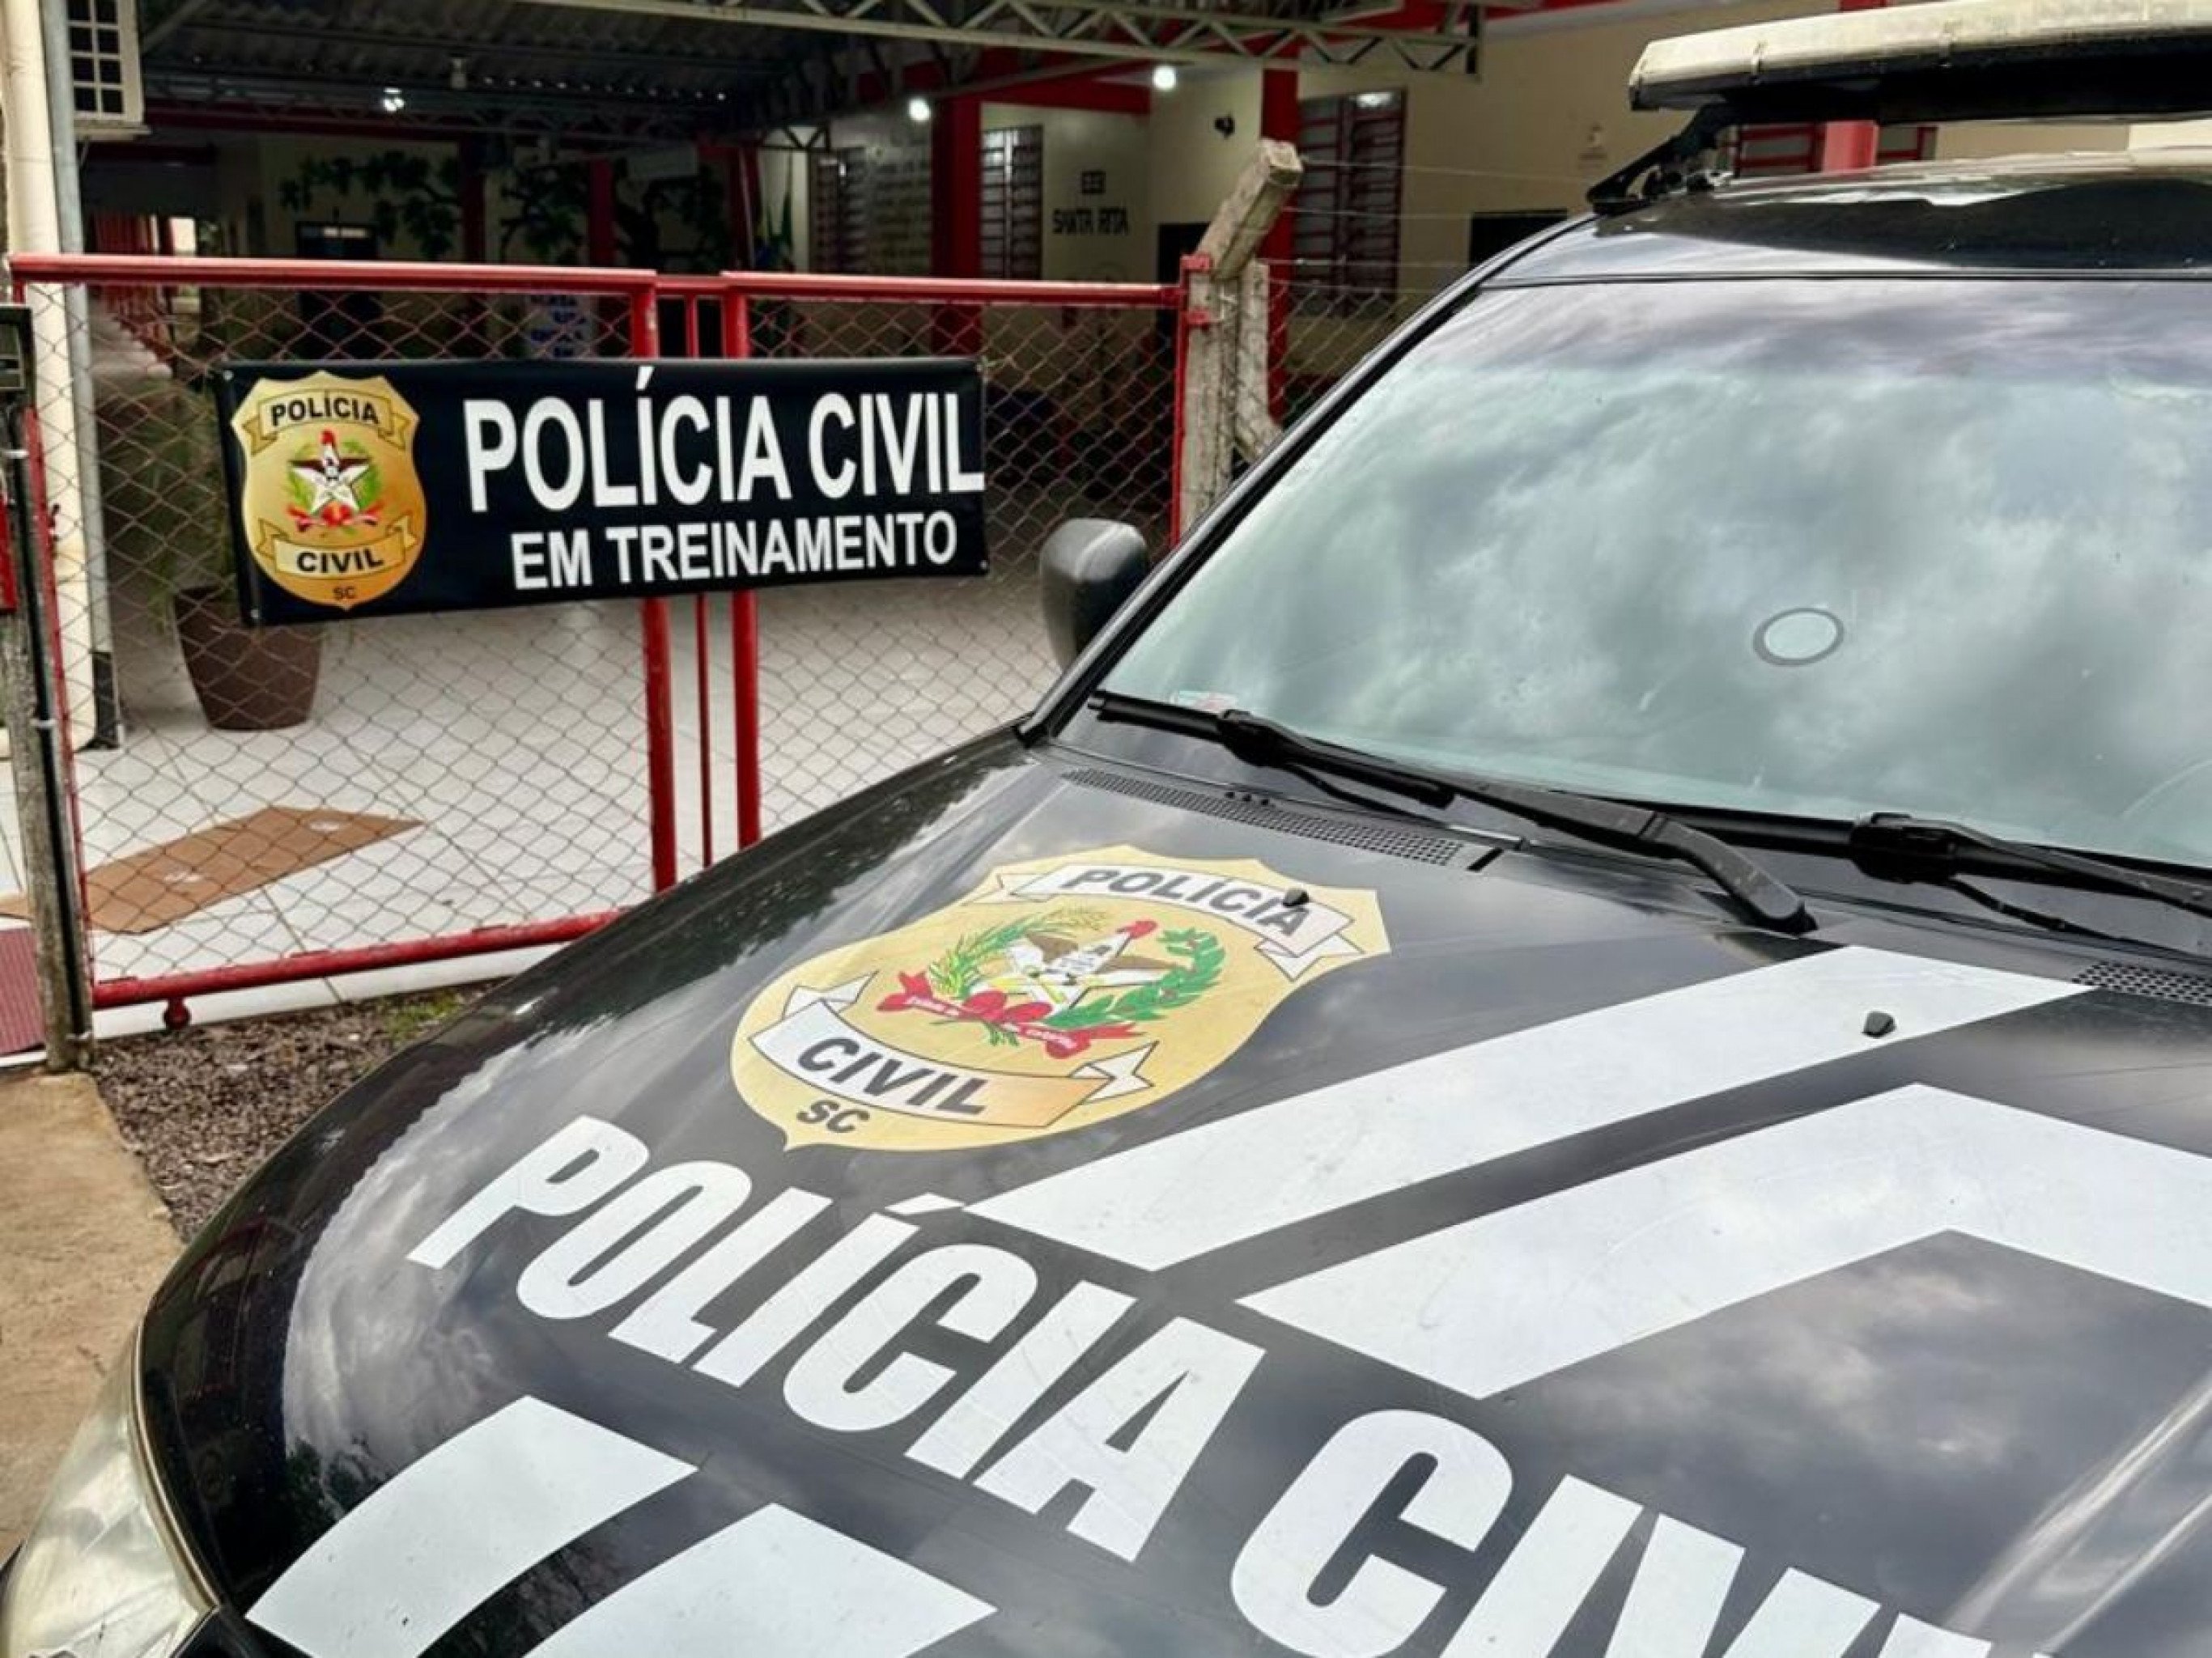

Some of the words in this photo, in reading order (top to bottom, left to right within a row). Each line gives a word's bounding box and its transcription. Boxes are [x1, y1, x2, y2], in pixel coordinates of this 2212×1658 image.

[271, 392, 380, 426] POLÍCIA
[464, 366, 792, 512] POLÍCIA
[810, 392, 985, 499] CIVIL
[296, 549, 384, 575] CIVIL
[511, 528, 592, 590] EM
[607, 511, 957, 583] TREINAMENTO
[333, 587, 357, 601] SC
[796, 1036, 988, 1115] CIVIL
[796, 1099, 870, 1134] SC
[405, 1115, 1267, 1563] POLÍCIA
